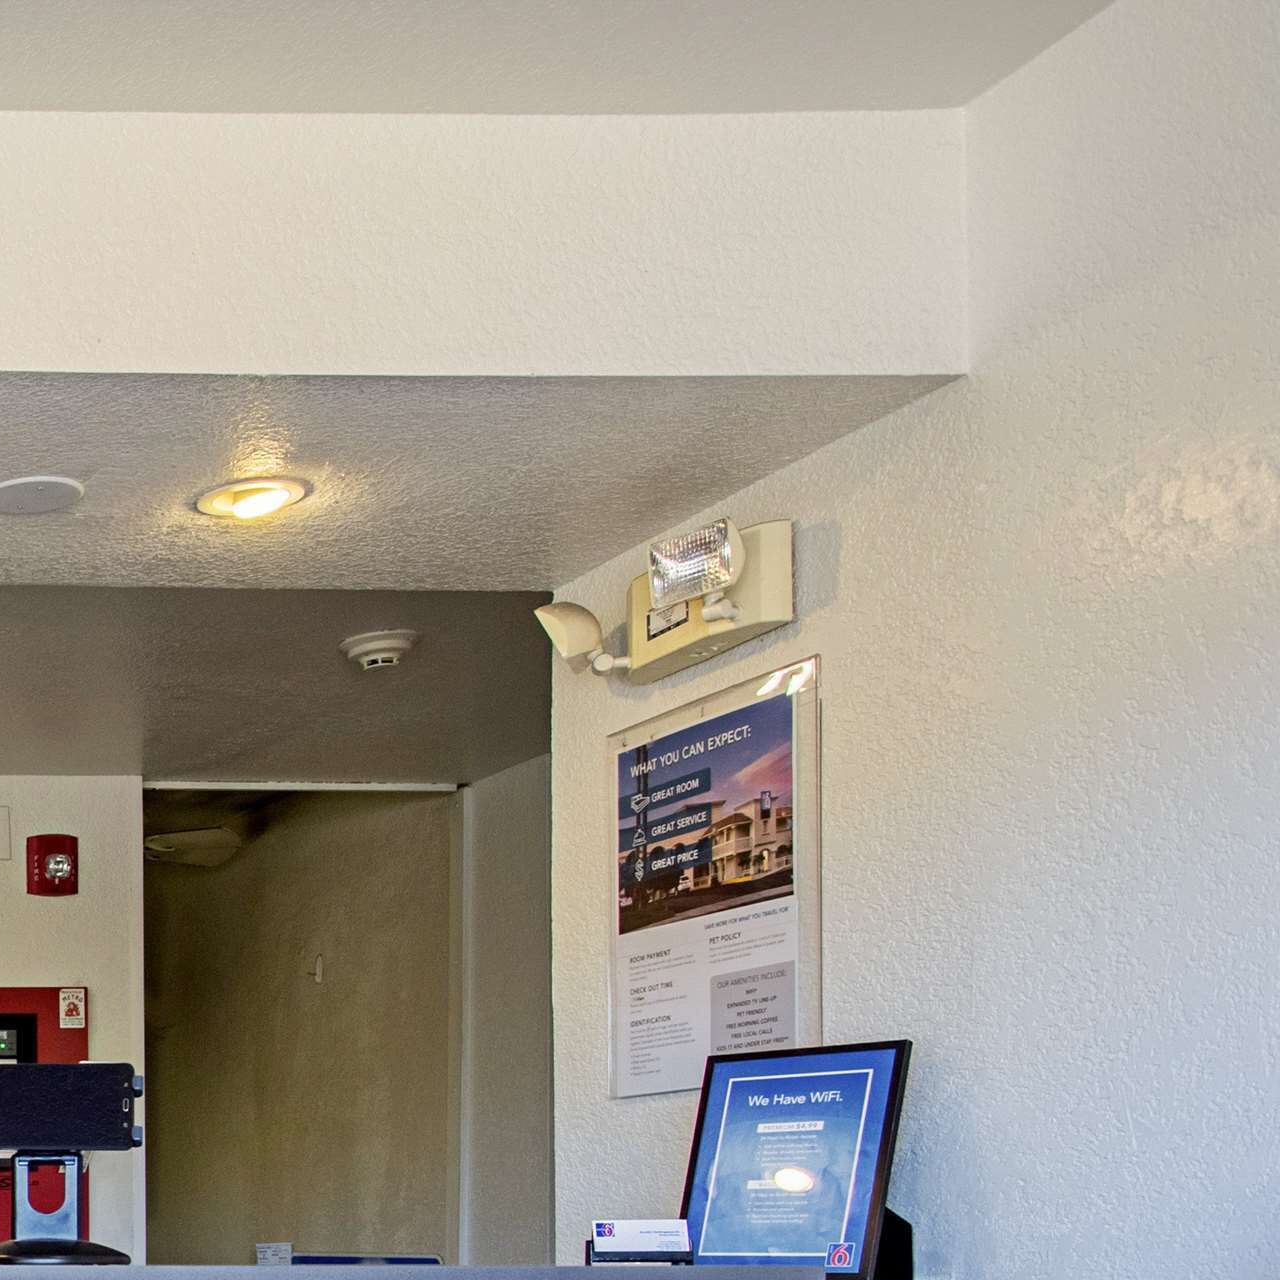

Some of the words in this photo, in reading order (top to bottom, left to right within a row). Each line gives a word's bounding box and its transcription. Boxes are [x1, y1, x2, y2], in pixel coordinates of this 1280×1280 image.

[630, 758, 658, 778] WHAT
[660, 750, 679, 767] YOU
[682, 741, 704, 759] CAN
[707, 725, 752, 751] EXPECT:
[651, 787, 675, 803] GREAT
[676, 778, 699, 794] ROOM
[651, 821, 675, 836] GREAT
[677, 811, 707, 829] SERVICE
[651, 856, 676, 871] GREAT
[677, 849, 699, 863] PRICE
[709, 935, 719, 945] PET
[720, 931, 741, 942] POLICY
[748, 1095, 769, 1106] We
[773, 1093, 806, 1105] Have
[810, 1090, 843, 1103] WiFi.
[831, 1243, 849, 1267] 6
